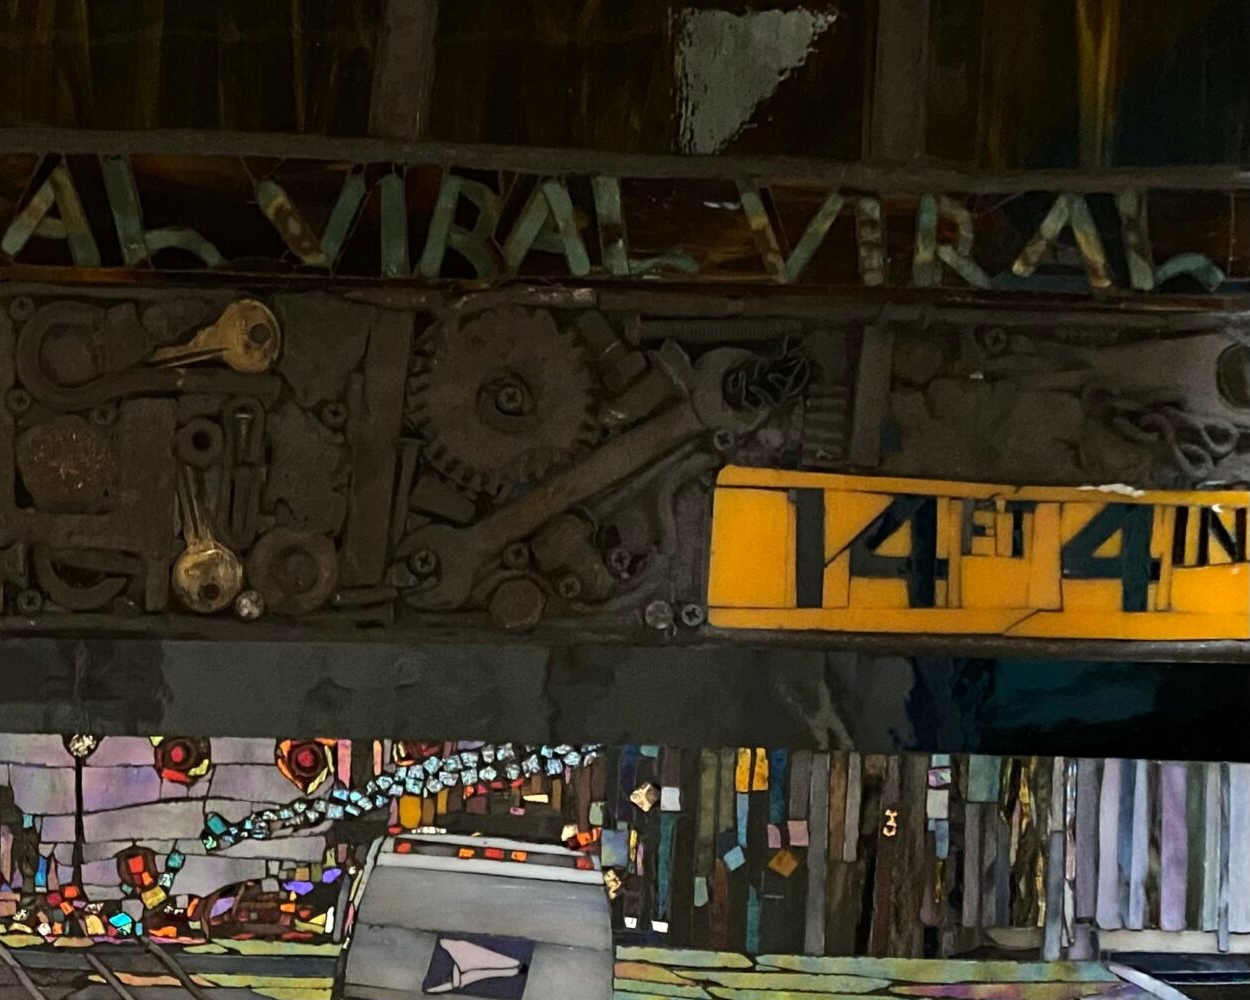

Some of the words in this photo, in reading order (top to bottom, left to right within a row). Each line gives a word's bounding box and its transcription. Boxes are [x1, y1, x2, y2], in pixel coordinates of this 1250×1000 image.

[256, 174, 700, 277] VIRAL
[739, 190, 1226, 292] VIRAL
[794, 488, 949, 608] 14
[961, 499, 1036, 557] FT
[1061, 503, 1161, 612] 4
[1172, 505, 1247, 567] IN
